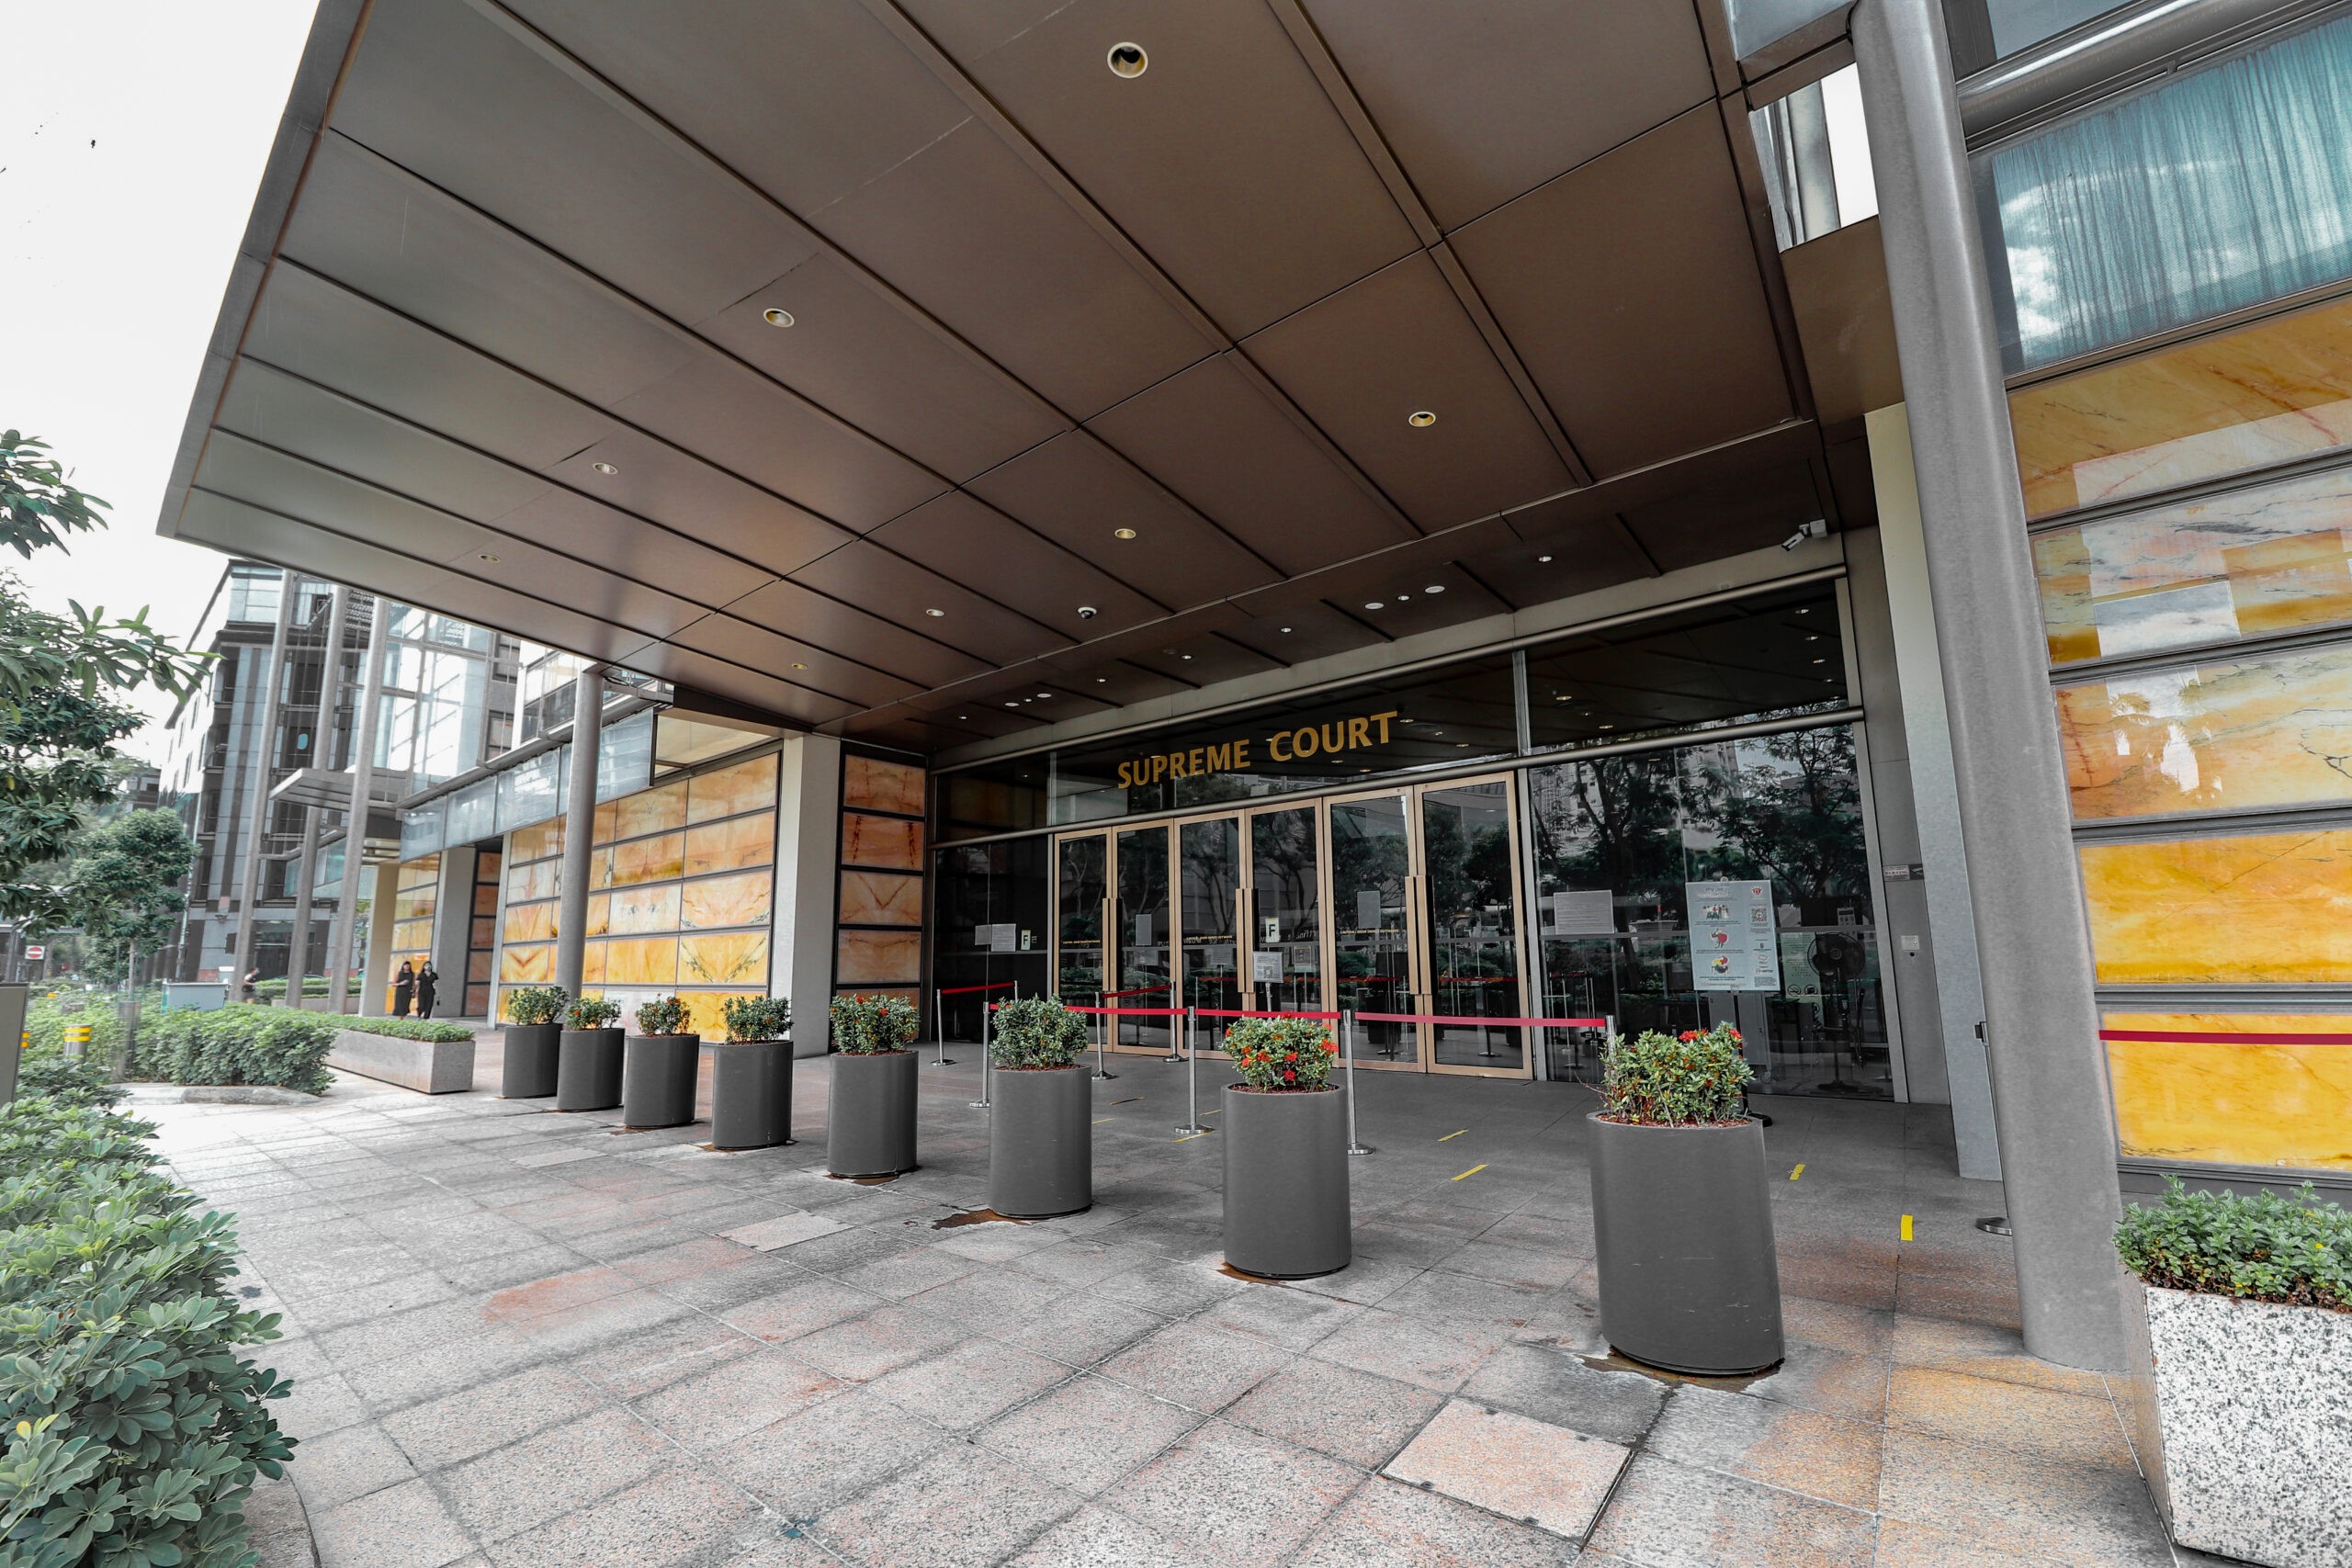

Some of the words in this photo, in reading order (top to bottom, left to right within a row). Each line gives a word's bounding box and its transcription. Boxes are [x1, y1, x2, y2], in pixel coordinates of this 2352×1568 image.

[1118, 739, 1250, 789] SUPREME
[1270, 710, 1397, 762] COURT
[1269, 923, 1276, 937] F
[1022, 934, 1029, 946] F
